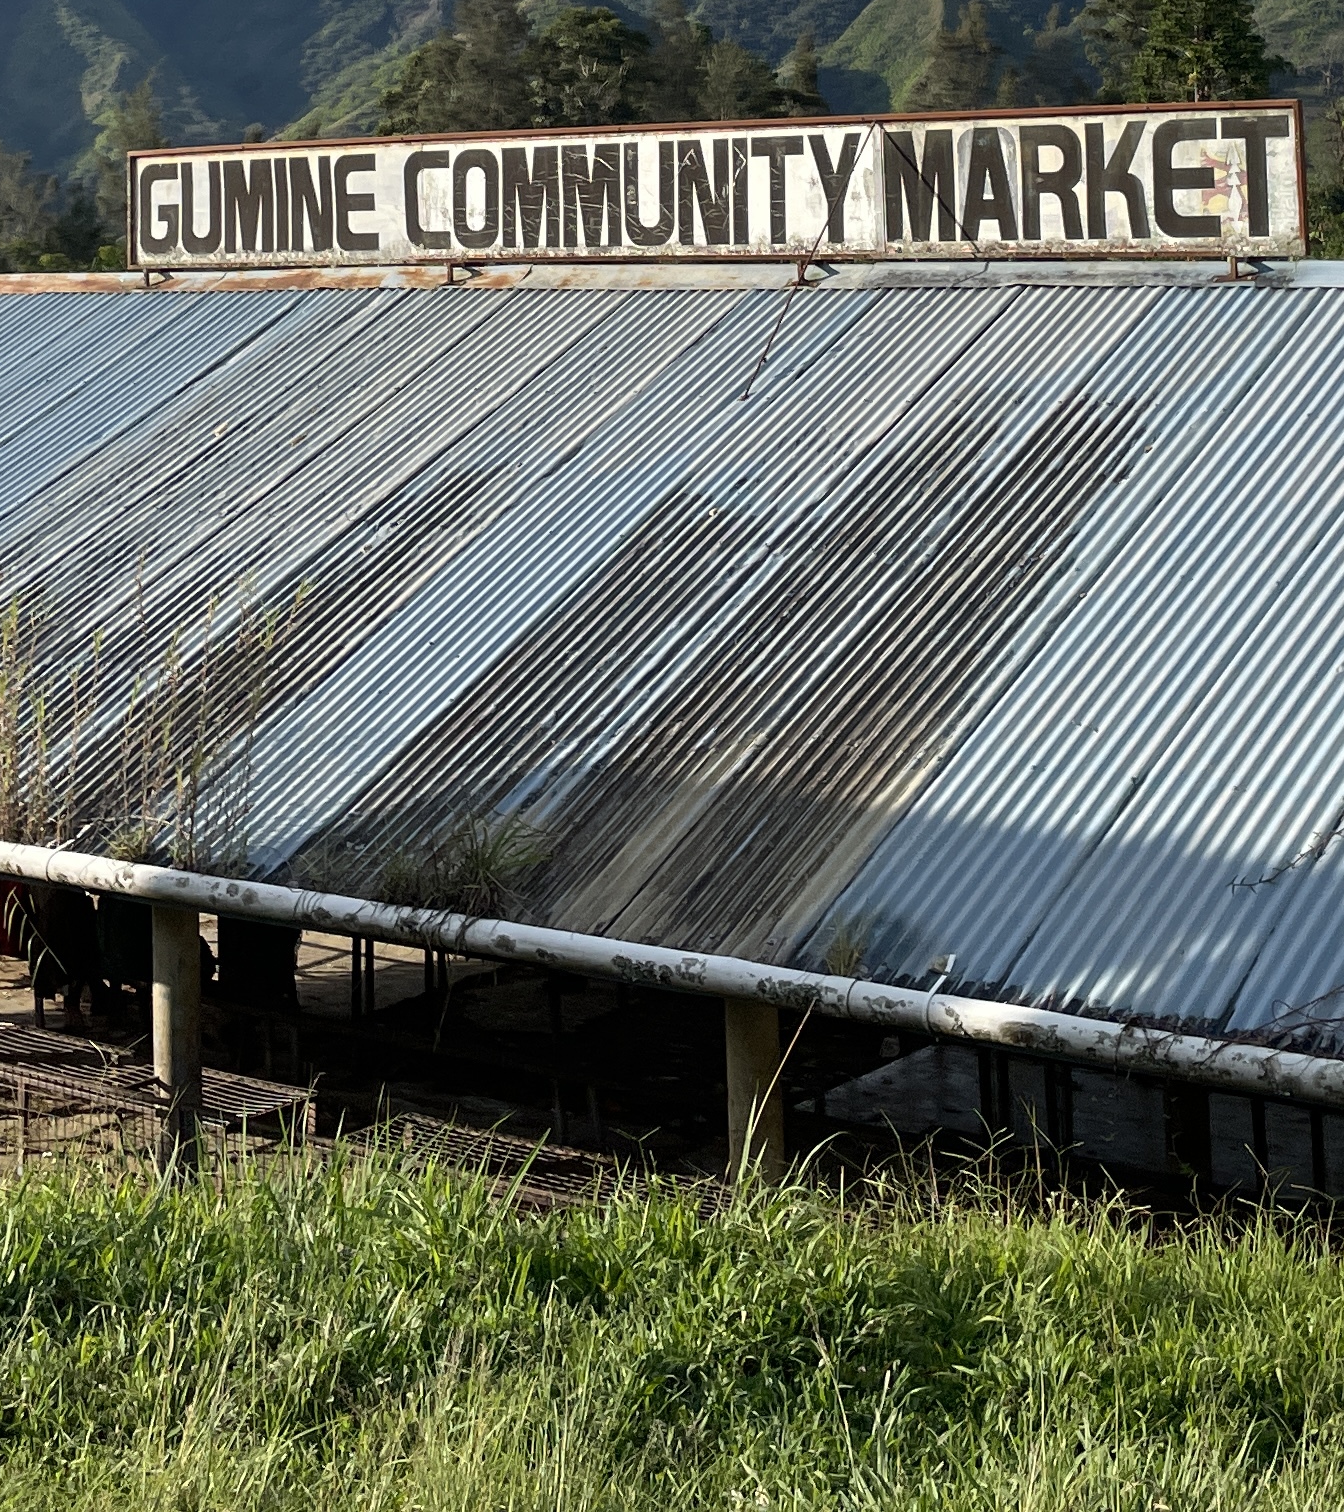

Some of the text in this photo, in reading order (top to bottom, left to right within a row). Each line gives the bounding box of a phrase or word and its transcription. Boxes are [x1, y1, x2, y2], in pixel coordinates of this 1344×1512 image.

[140, 153, 380, 254] GUMINE
[404, 133, 861, 249] COMMUNITY
[884, 115, 1290, 242] MARKET
